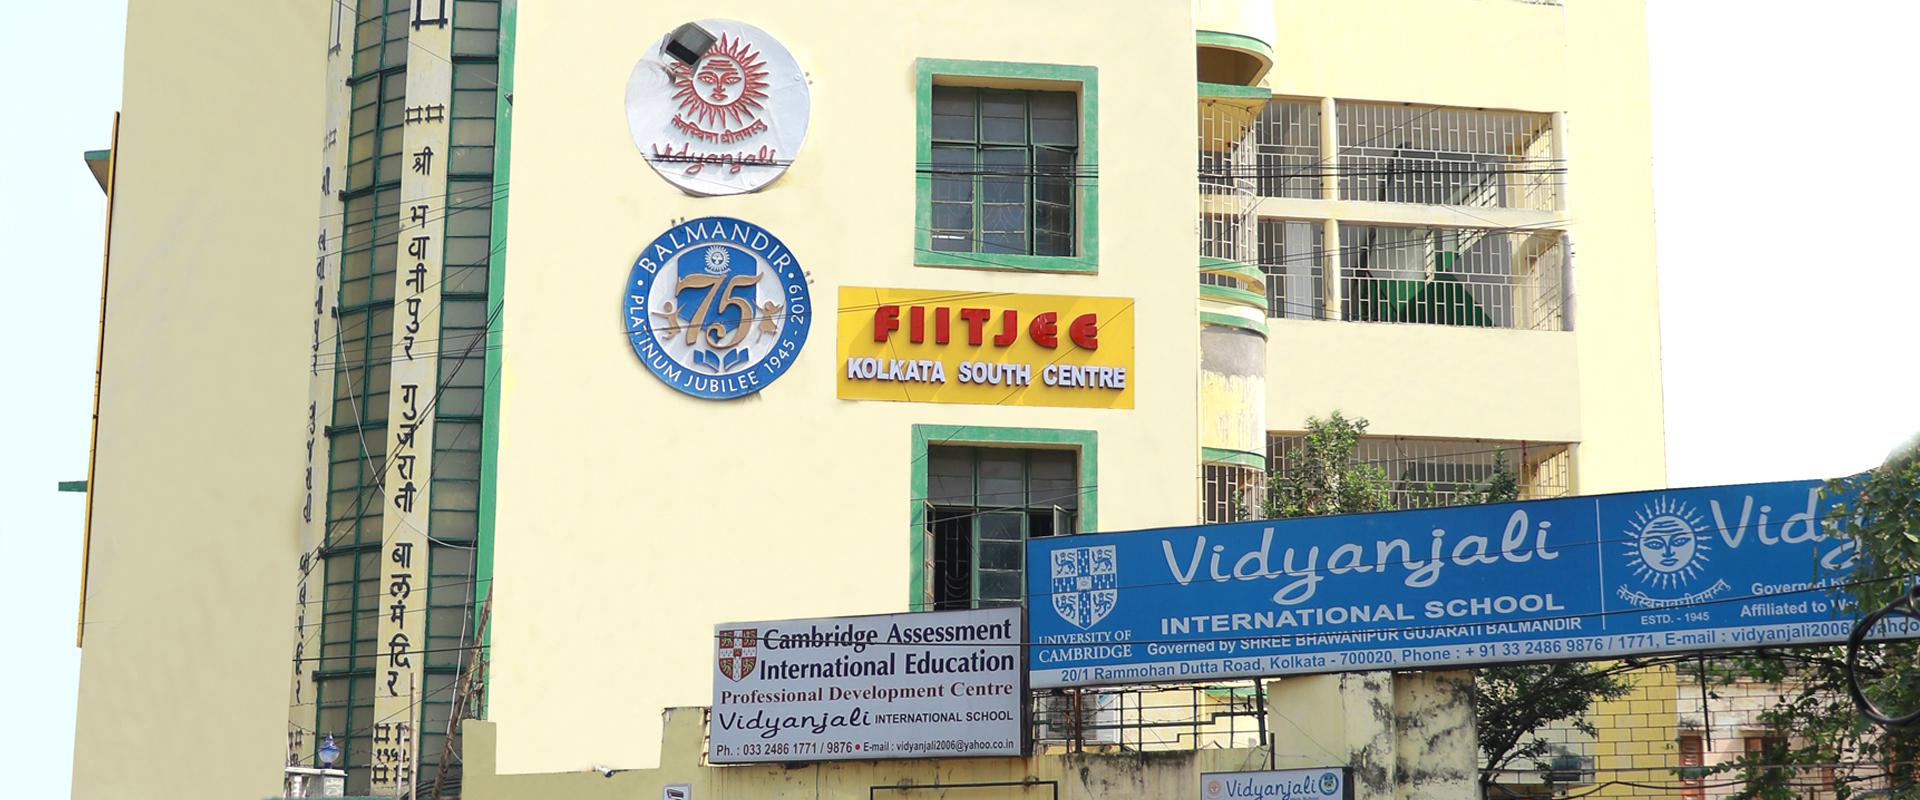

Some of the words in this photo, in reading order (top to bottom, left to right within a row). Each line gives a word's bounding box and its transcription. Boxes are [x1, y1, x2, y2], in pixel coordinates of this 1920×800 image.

[653, 142, 777, 174] Vidyanjali
[639, 221, 792, 274] BALMANDIR
[675, 272, 764, 348] 75
[630, 294, 682, 382] PLATINUM
[684, 370, 759, 393] JUBILEE
[764, 339, 795, 374] 1945
[788, 284, 804, 325] 2019
[874, 305, 1098, 350] FIITJEE
[847, 357, 946, 384] KOLKATA
[958, 361, 1032, 387] SOUTH
[1042, 364, 1126, 389] CENTRE
[1162, 509, 1559, 605] Vidyanjali
[1161, 603, 1415, 635] INTERNATIONAL
[1424, 593, 1565, 618] SCHOOL
[1641, 614, 1674, 625] ESTD.
[1684, 612, 1710, 622] 1945
[1740, 600, 1807, 618] Affiliated
[1811, 601, 1827, 613] to
[763, 624, 878, 652] Cambridge
[887, 618, 1012, 644] Assessment
[1038, 631, 1114, 645] UNIVERSITY
[1116, 630, 1132, 641] OF
[1147, 640, 1216, 656] Governed
[1219, 638, 1236, 654] by
[1240, 636, 1291, 650] SHREE
[1295, 630, 1397, 647] BHAWANIPUR
[1403, 624, 1482, 641] GUJARATI
[1486, 617, 1582, 636] BALMANDIR
[760, 652, 895, 680] International
[905, 649, 1015, 675] Education
[1038, 644, 1132, 663] CAMBRIDGE
[1061, 668, 1089, 682] 20/1
[1094, 664, 1175, 681] Rammohan
[1180, 661, 1218, 676] Dutta
[1223, 658, 1265, 674] Road,
[1270, 653, 1326, 670] Kolkata
[1341, 650, 1397, 666] 700020,
[1402, 647, 1450, 662] Phone
[1479, 643, 1496, 657] 91
[1502, 641, 1520, 656] 33
[1524, 640, 1561, 654] 2486
[1567, 637, 1604, 652] 9876
[1618, 634, 1660, 649] 1771,
[1665, 630, 1716, 646] E-mail
[720, 686, 823, 704] Professional
[829, 684, 944, 703] Development
[950, 680, 1013, 697] Centre
[719, 706, 871, 739] Vidyanjali
[875, 712, 963, 725] INTERNATIONAL
[966, 710, 1013, 722] SCHOOL
[716, 744, 733, 757] Ph.
[743, 743, 762, 756] 033
[764, 742, 789, 755] 2486
[793, 742, 818, 755] 1771
[826, 741, 853, 754] 9876
[863, 741, 890, 752] E-mail
[896, 739, 1014, 754] vidyanjali2006@yahoo.co.in
[1226, 775, 1317, 800] Vidyanjali
